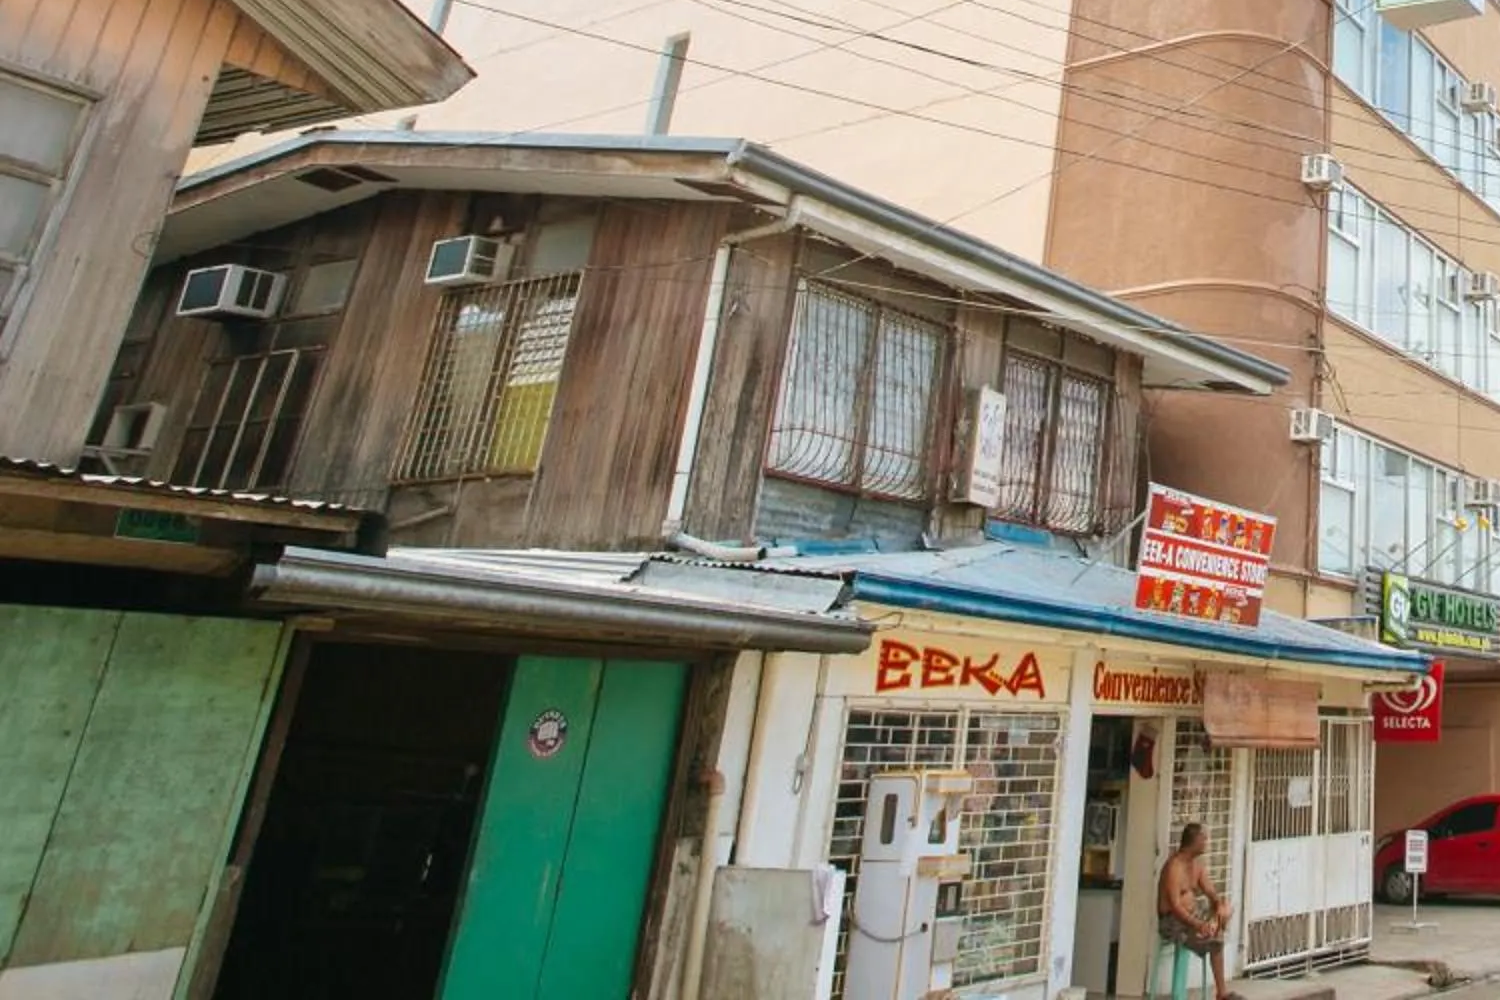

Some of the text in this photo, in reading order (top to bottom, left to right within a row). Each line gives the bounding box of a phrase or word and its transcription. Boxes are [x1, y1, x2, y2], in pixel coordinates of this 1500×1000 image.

[1175, 545, 1240, 580] CONVENIENCE
[1416, 587, 1439, 619] GV
[1445, 592, 1497, 632] HOTELS
[1092, 660, 1191, 705] Convenience
[1383, 716, 1431, 729] SELECTA
